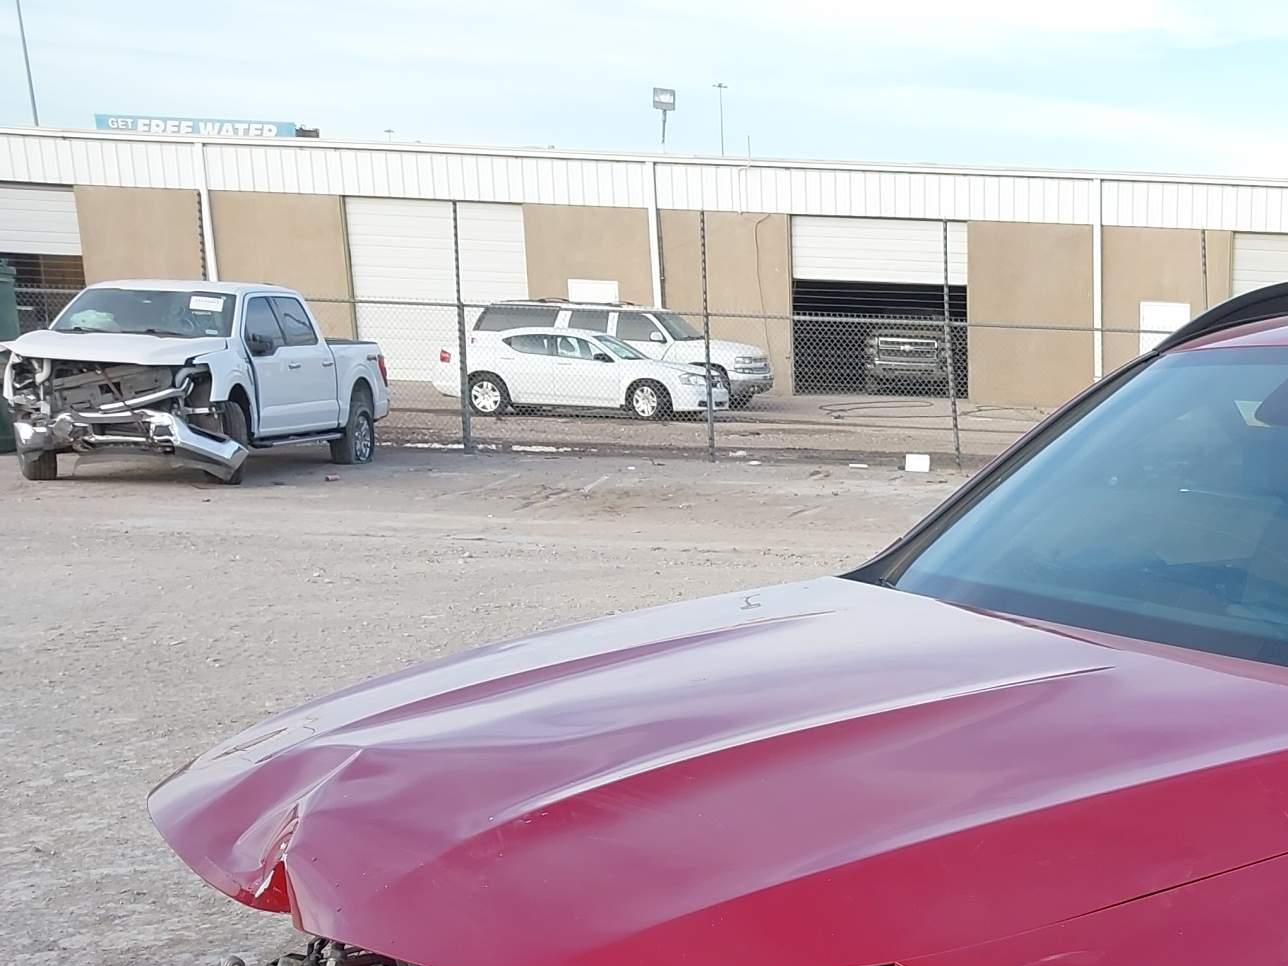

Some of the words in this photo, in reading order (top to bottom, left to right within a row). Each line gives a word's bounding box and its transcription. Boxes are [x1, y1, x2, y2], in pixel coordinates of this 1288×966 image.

[108, 117, 134, 130] GET
[136, 118, 194, 135] FREE
[198, 121, 278, 137] WATER
